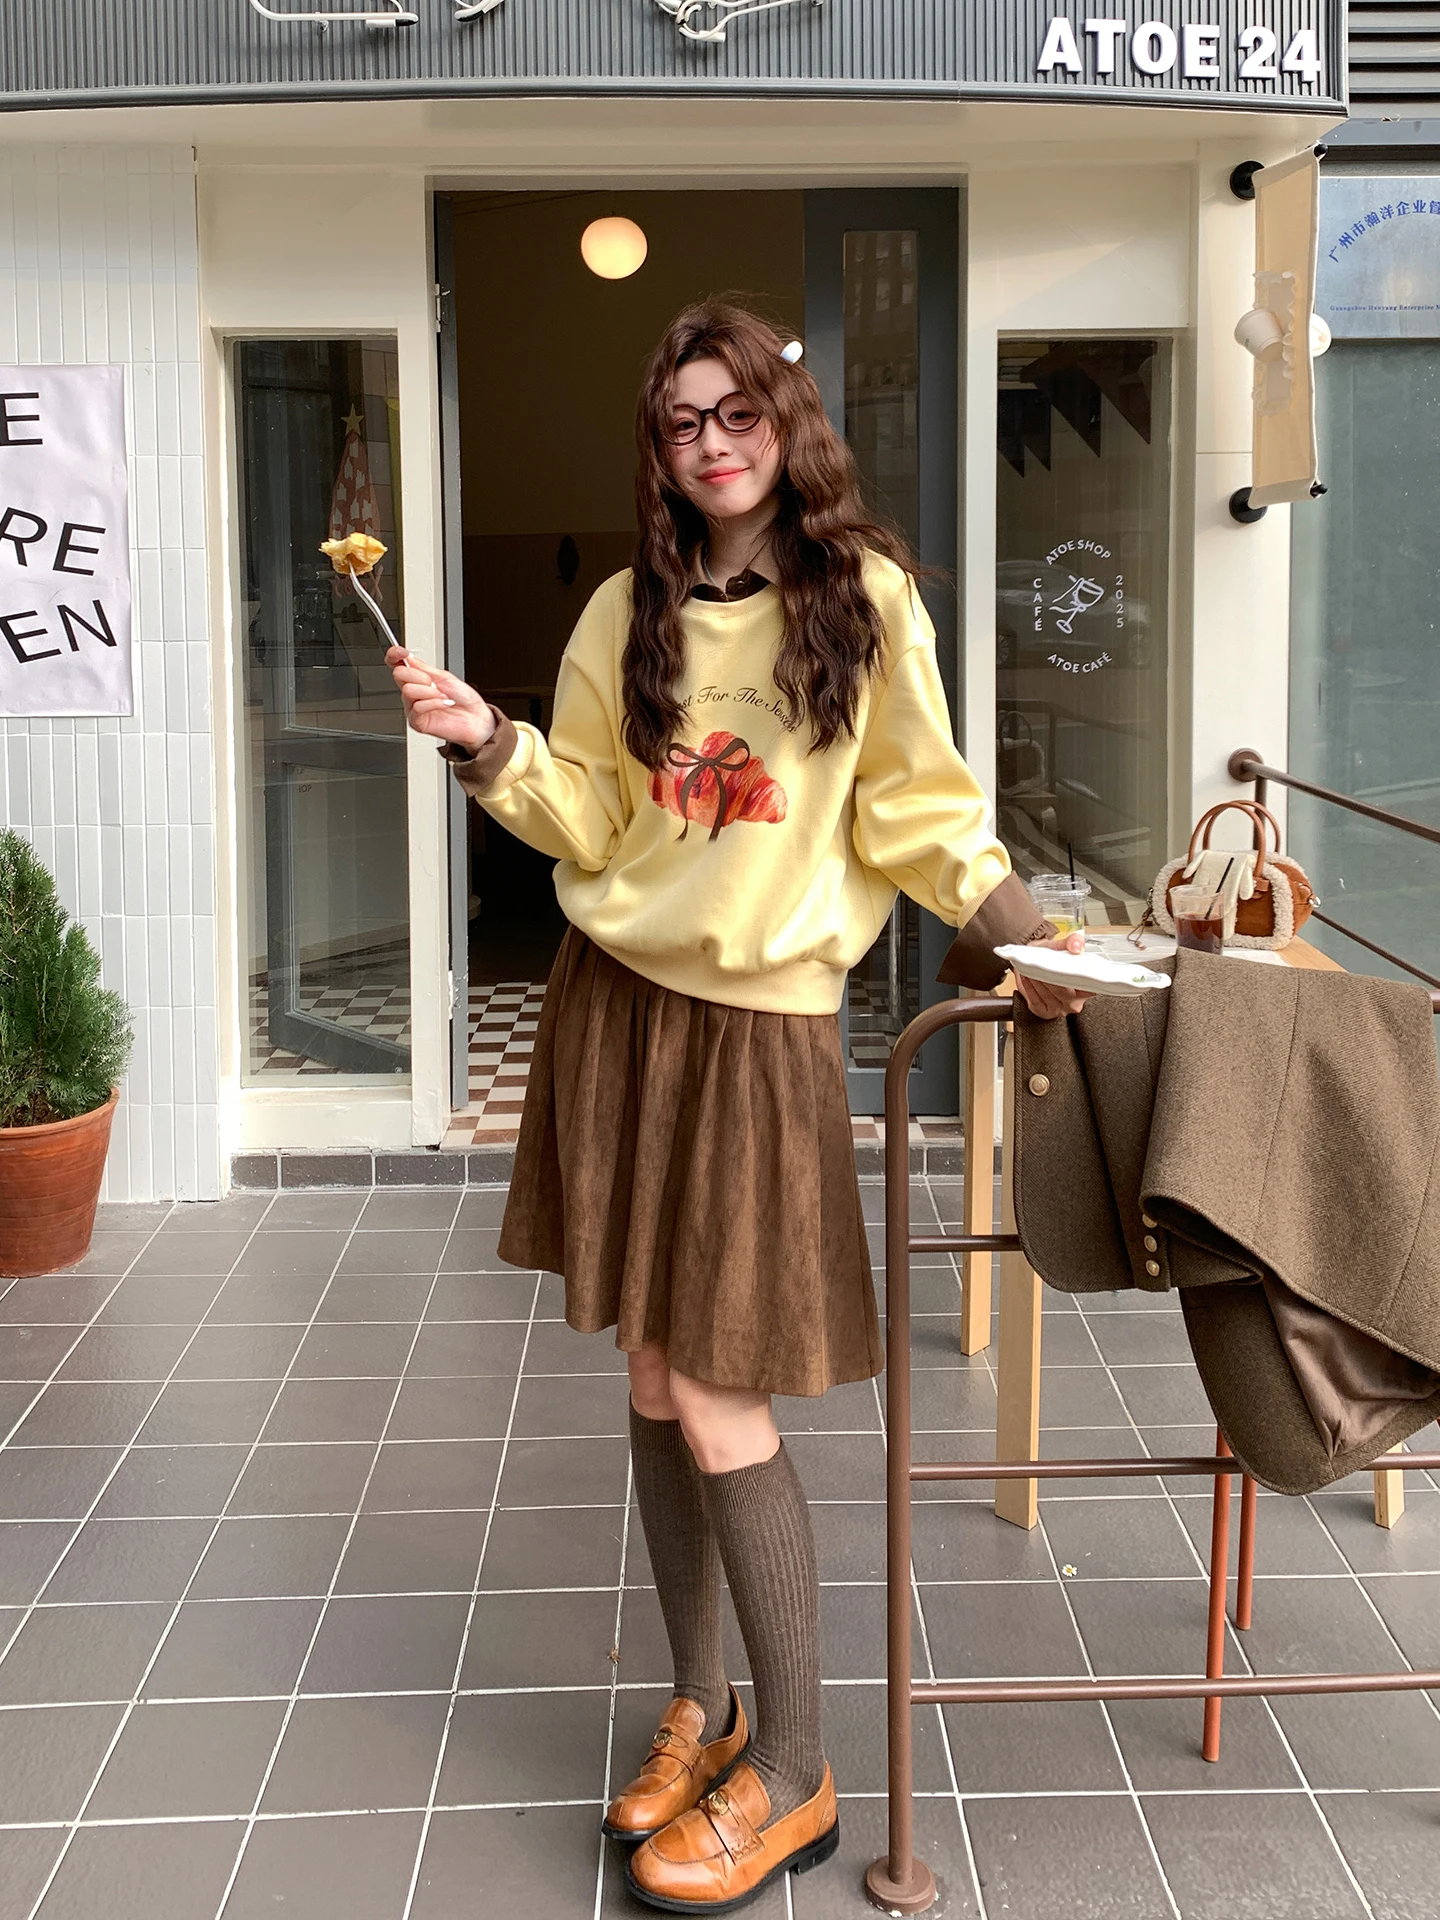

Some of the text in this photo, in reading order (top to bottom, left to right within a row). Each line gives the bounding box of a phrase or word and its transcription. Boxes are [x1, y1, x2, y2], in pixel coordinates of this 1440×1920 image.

[1036, 17, 1321, 82] ATOE 24
[0, 392, 43, 447] E
[0, 507, 106, 576] RE
[1045, 539, 1112, 566] ATOE SHOP
[1033, 578, 1043, 631] CAFÉ
[1115, 575, 1124, 628] 2025
[0, 599, 117, 664] EN
[1047, 651, 1112, 673] ATOE CAFÉ
[697, 686, 730, 704] For
[733, 687, 766, 707] The
